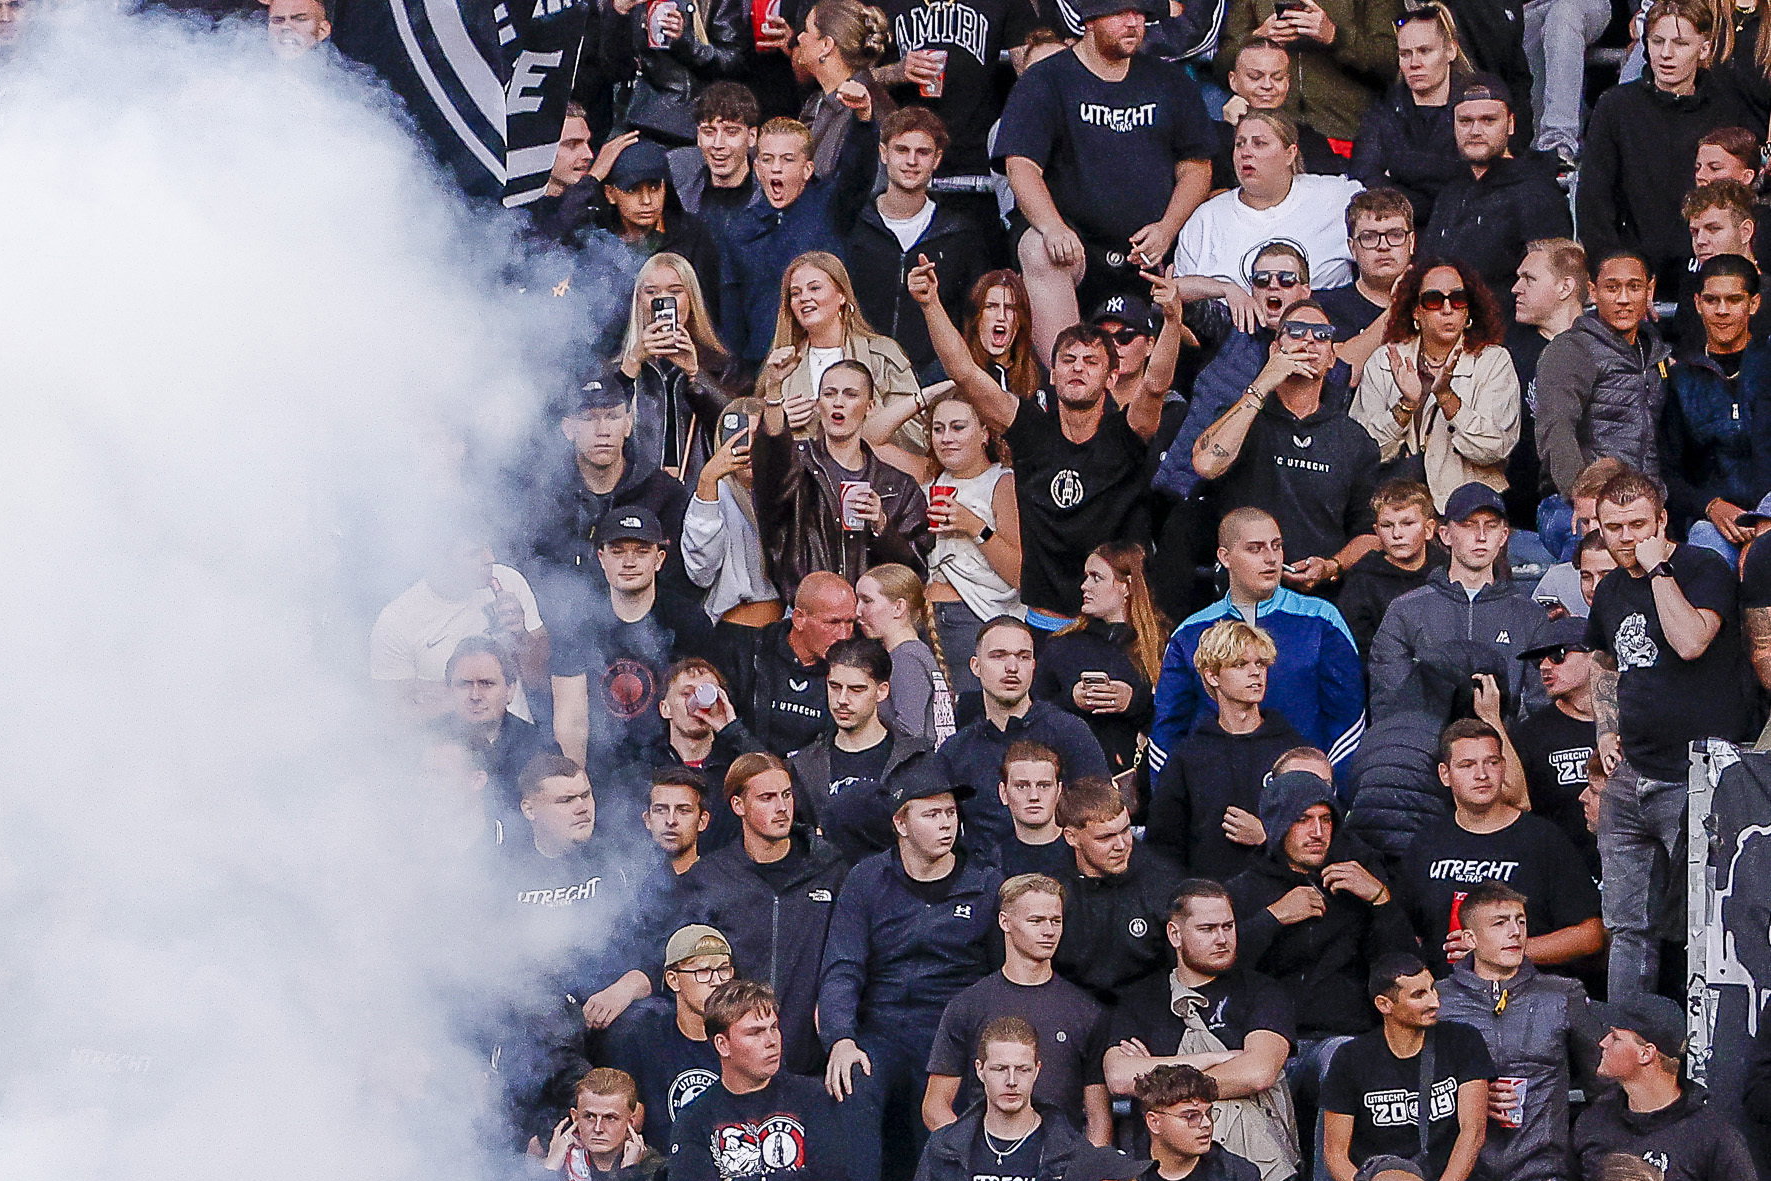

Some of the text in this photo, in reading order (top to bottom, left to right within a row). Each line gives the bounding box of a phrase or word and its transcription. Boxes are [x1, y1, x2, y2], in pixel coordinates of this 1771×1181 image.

[894, 2, 989, 66] AMIRI
[1080, 103, 1157, 126] UTRECHT
[1287, 458, 1330, 473] UTRECHT
[779, 701, 821, 718] UTRECHT
[1552, 752, 1589, 763] UTRECHT
[1430, 859, 1520, 882] UTRECHT
[517, 876, 602, 905] UTRECHT
[1368, 1093, 1405, 1104] UTRECHT
